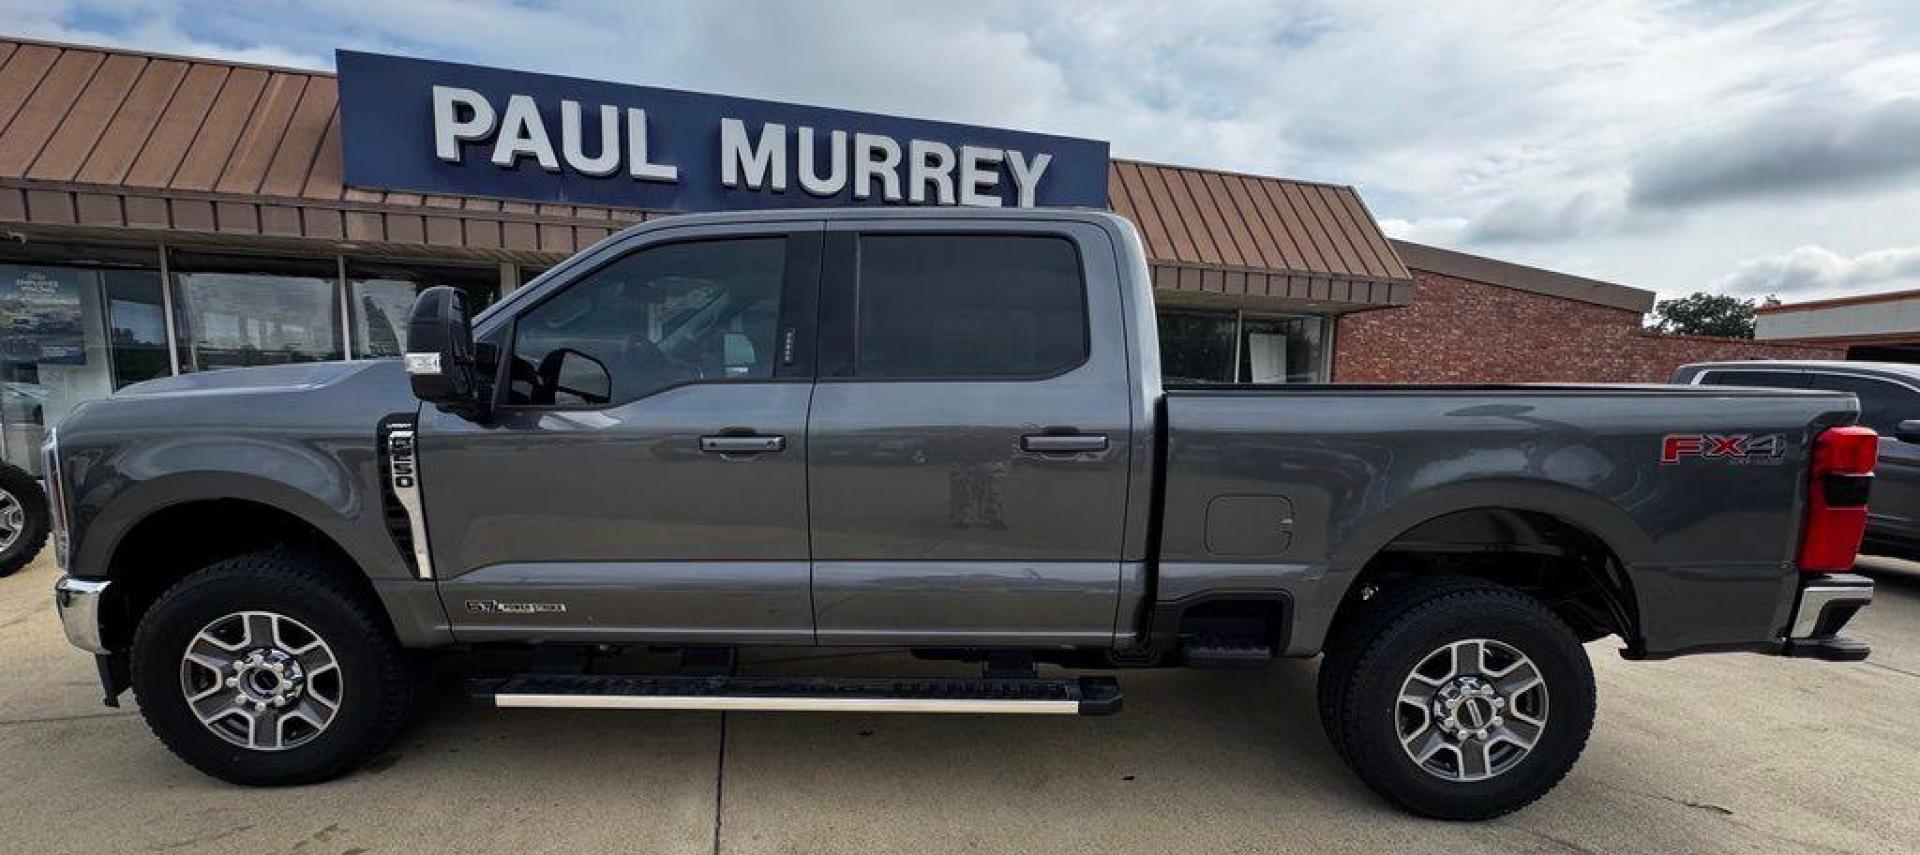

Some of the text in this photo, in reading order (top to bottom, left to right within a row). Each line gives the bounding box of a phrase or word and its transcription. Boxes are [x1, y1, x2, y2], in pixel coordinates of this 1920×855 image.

[432, 85, 1053, 208] PAUL MURREY
[1661, 434, 1784, 464] FX4
